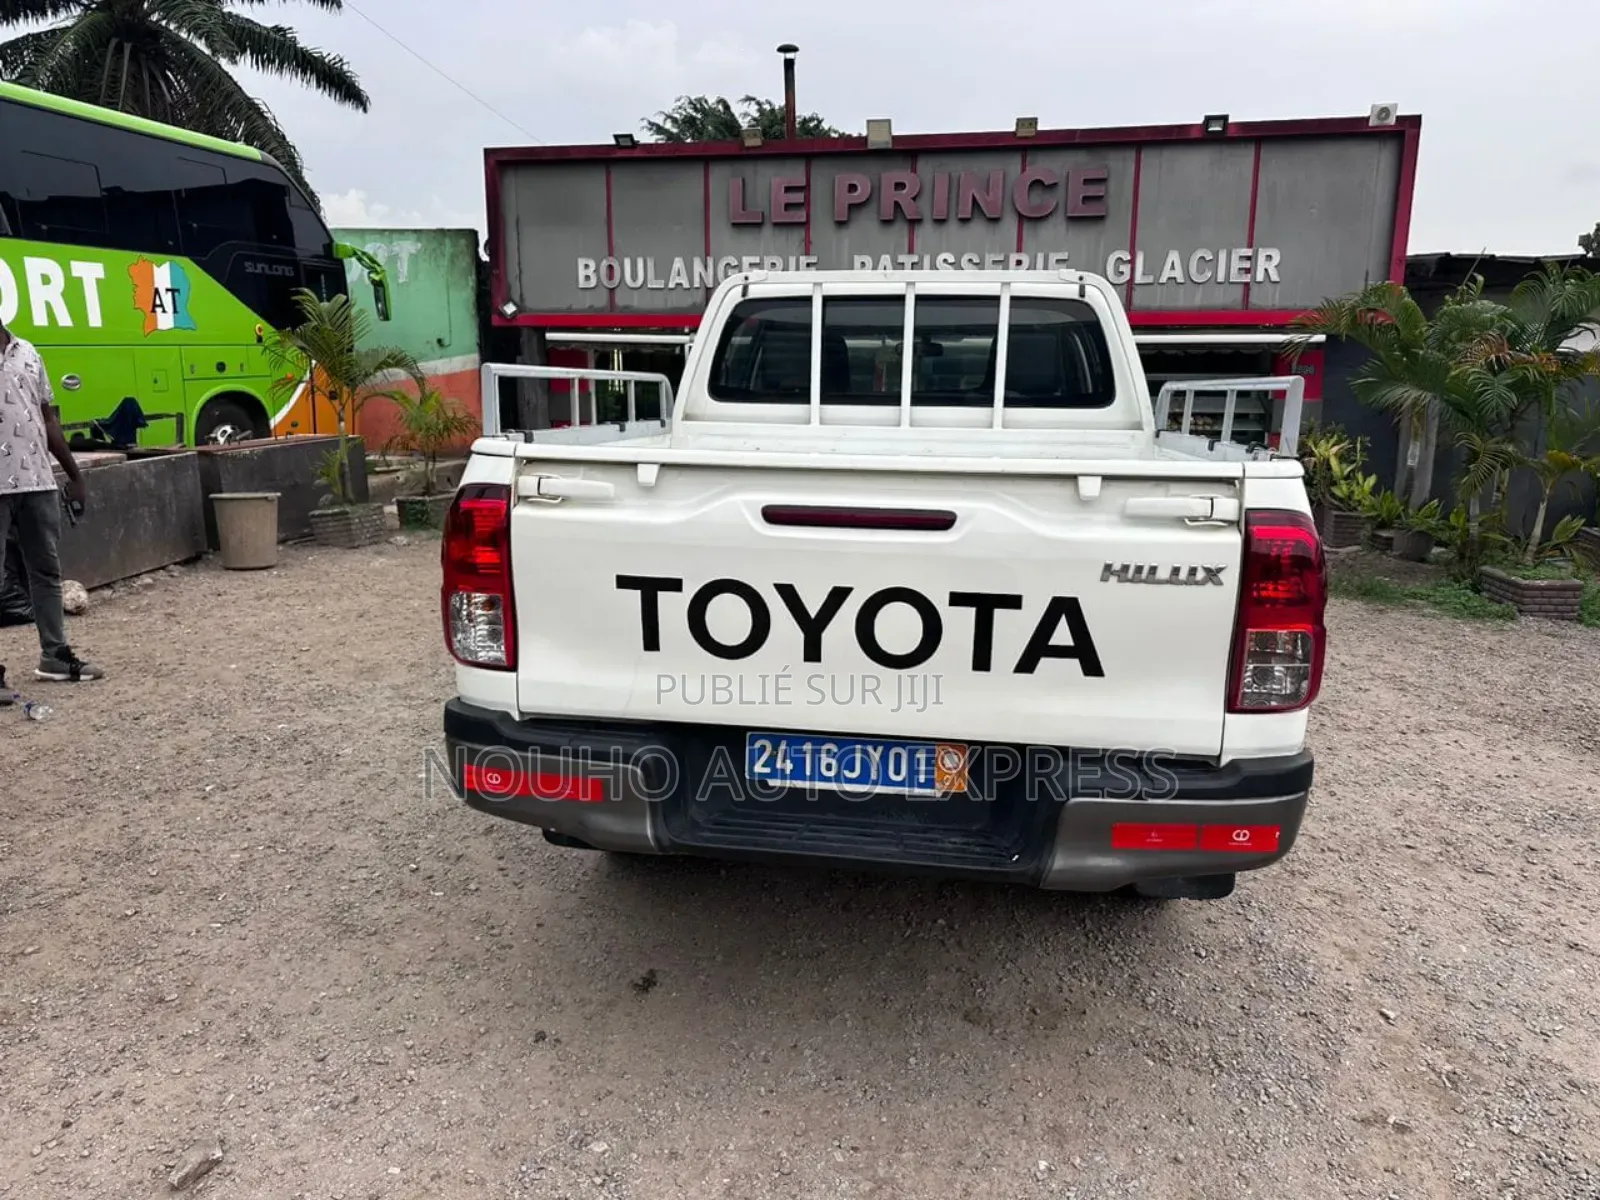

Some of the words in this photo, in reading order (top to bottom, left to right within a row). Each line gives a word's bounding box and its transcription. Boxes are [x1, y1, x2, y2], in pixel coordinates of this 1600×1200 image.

[728, 177, 807, 225] LE
[834, 166, 1108, 222] PRINCE
[1105, 248, 1281, 285] GLACIER
[150, 287, 181, 314] AT
[1100, 560, 1227, 586] HILUX
[616, 574, 1105, 677] TOYOTA
